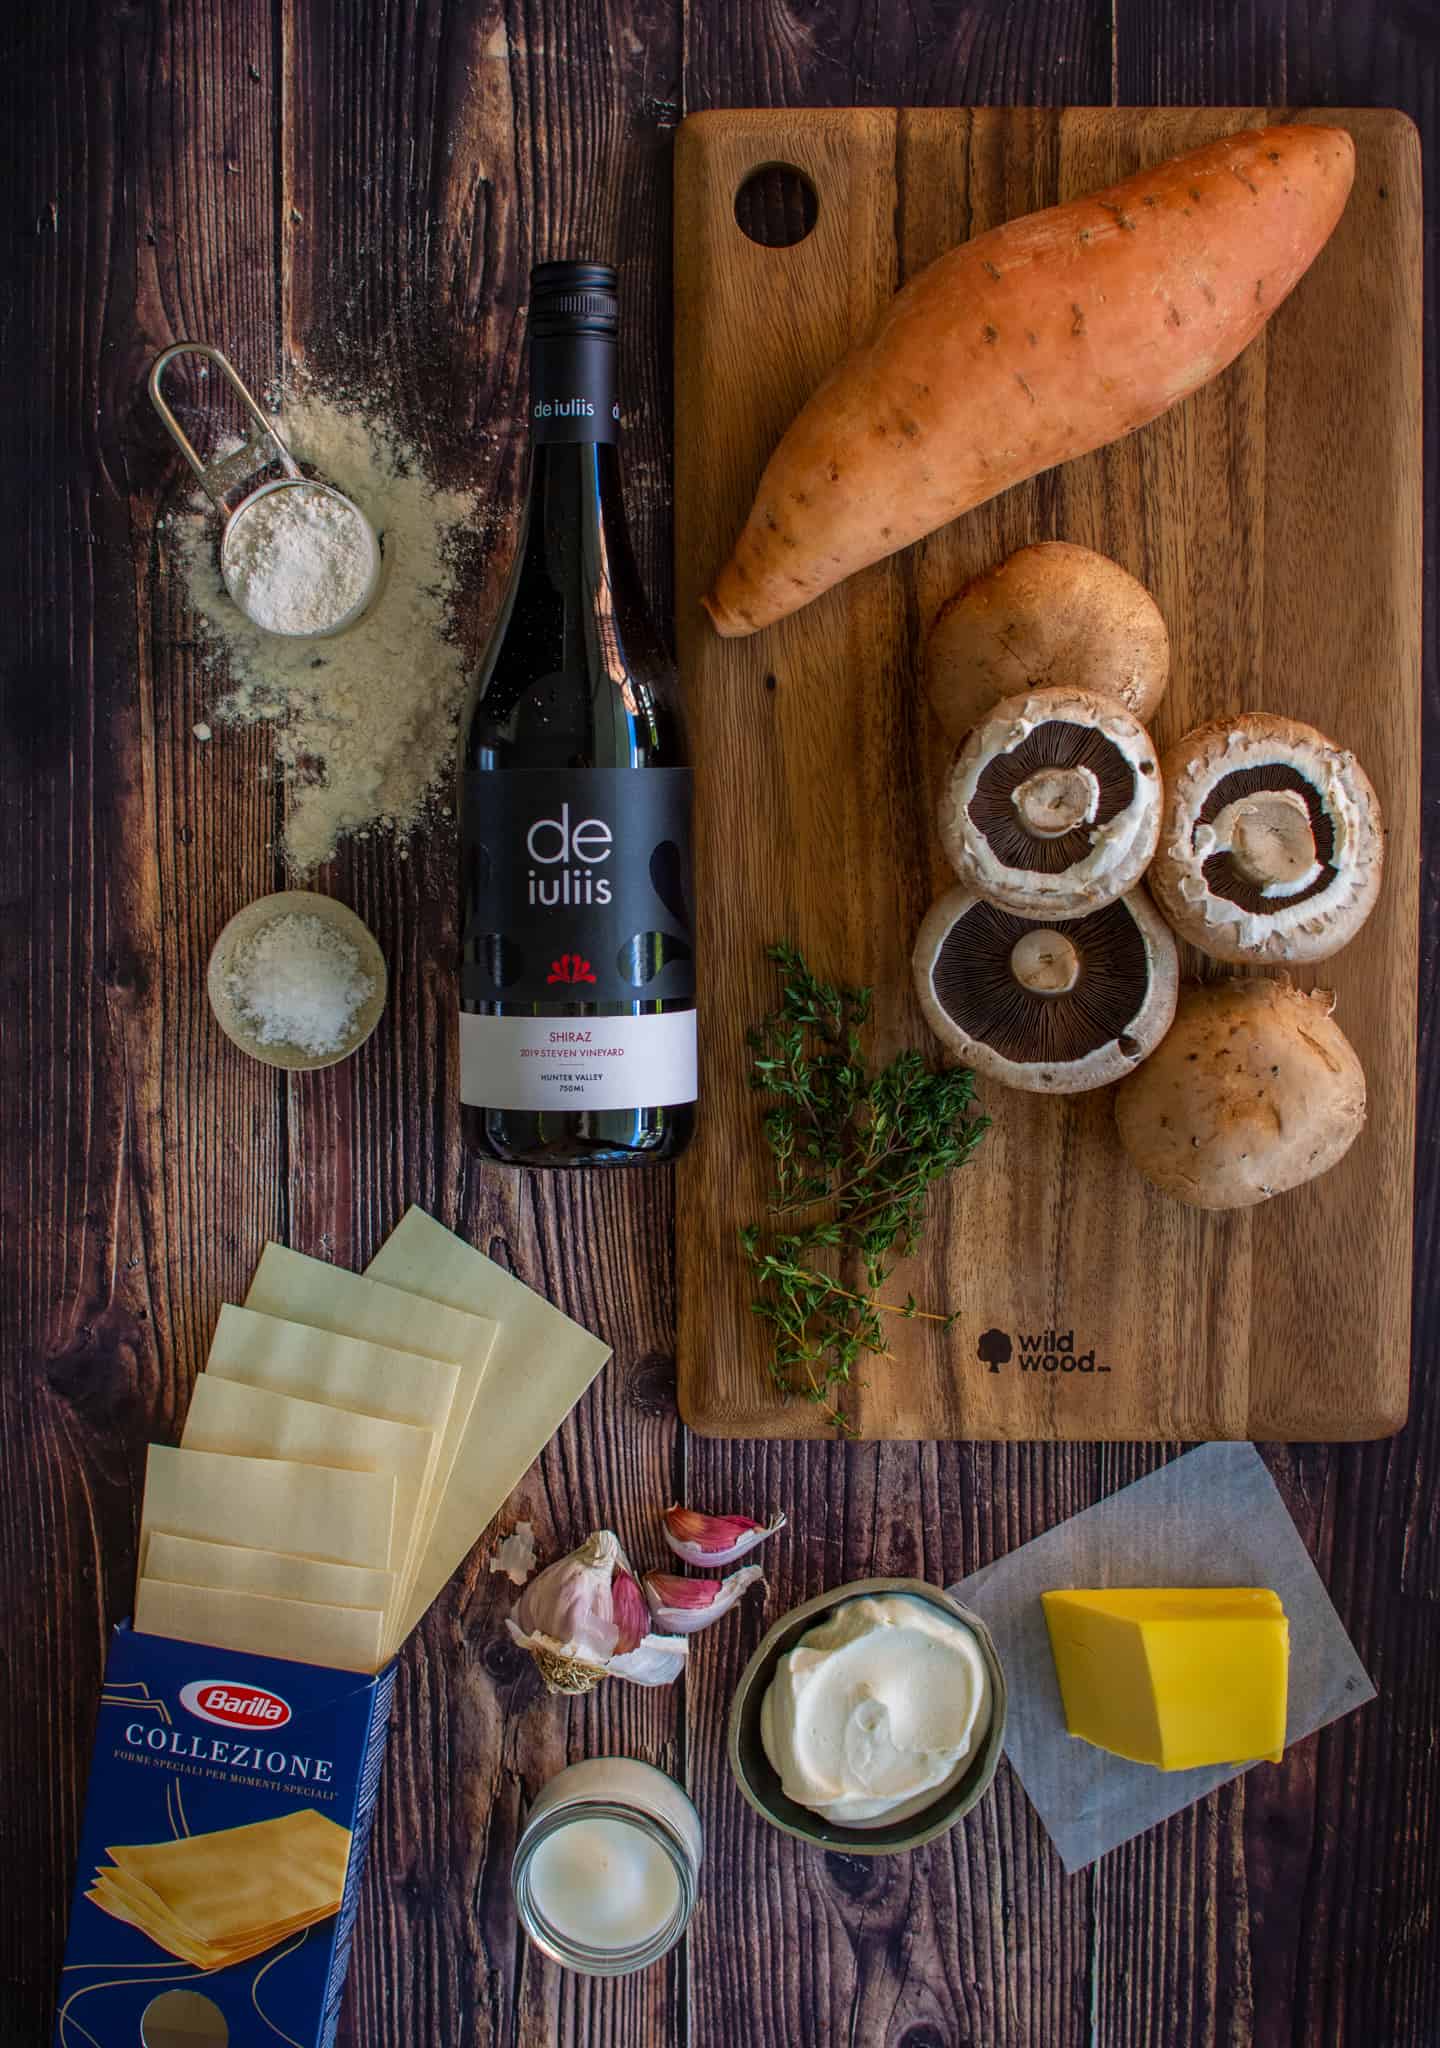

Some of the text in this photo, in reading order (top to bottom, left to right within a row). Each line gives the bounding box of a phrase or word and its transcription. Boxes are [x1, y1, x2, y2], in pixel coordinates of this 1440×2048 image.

[534, 398, 595, 418] de iuliis
[527, 803, 613, 863] de
[529, 870, 612, 904] iuliis
[549, 1032, 592, 1042] SHIRAZ
[520, 1048, 624, 1057] 2019 STEVEN VINEYARD
[559, 1084, 584, 1092] 750ML
[575, 1073, 603, 1081] VALLEY
[1018, 1330, 1074, 1353] wild
[204, 1689, 282, 1720] Barilla
[125, 1723, 333, 1783] COLLEZIONE
[113, 1749, 150, 1766] FORME
[152, 1759, 202, 1777] SPECIALI
[205, 1767, 227, 1781] PER
[230, 1773, 281, 1791] MOMENTI
